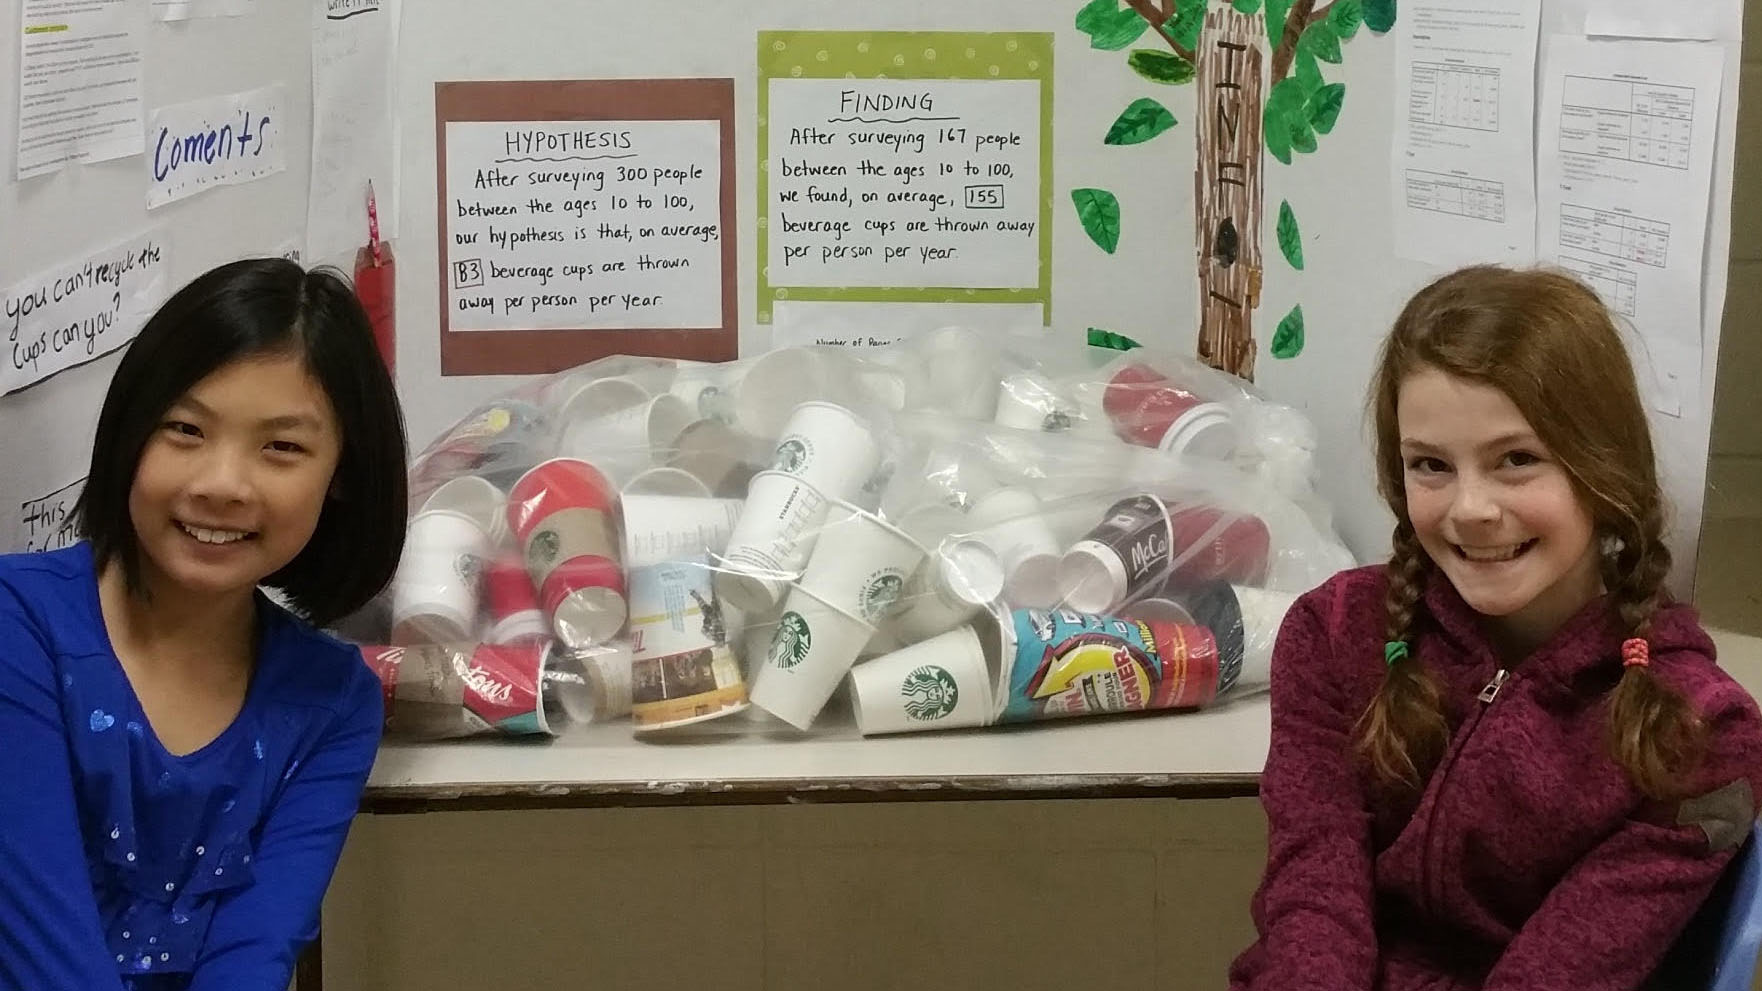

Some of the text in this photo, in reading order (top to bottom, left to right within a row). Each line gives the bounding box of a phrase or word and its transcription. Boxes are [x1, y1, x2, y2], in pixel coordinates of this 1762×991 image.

[840, 89, 933, 114] FINDING
[505, 130, 632, 156] HYPOTHESIS
[789, 126, 1021, 154] After surveying 167 people
[474, 163, 703, 192] After surveying 300 people
[781, 157, 1014, 185] between the ages 10 to 100,
[456, 193, 694, 219] between the ages 10 to 100,
[779, 185, 998, 212] we found, on average, 155
[455, 222, 719, 252] our hypothesis is that, on average,
[780, 211, 1036, 241] beverage cups are thrown away
[138, 241, 161, 269] the
[783, 245, 811, 267] per
[822, 245, 873, 265] person
[884, 246, 912, 264] per
[489, 259, 554, 287] beverage
[562, 263, 594, 282] cups
[601, 261, 626, 273] are
[636, 253, 690, 271] thrown
[458, 296, 494, 315] away
[504, 295, 525, 317] per
[531, 294, 578, 313] person
[588, 294, 617, 313] per
